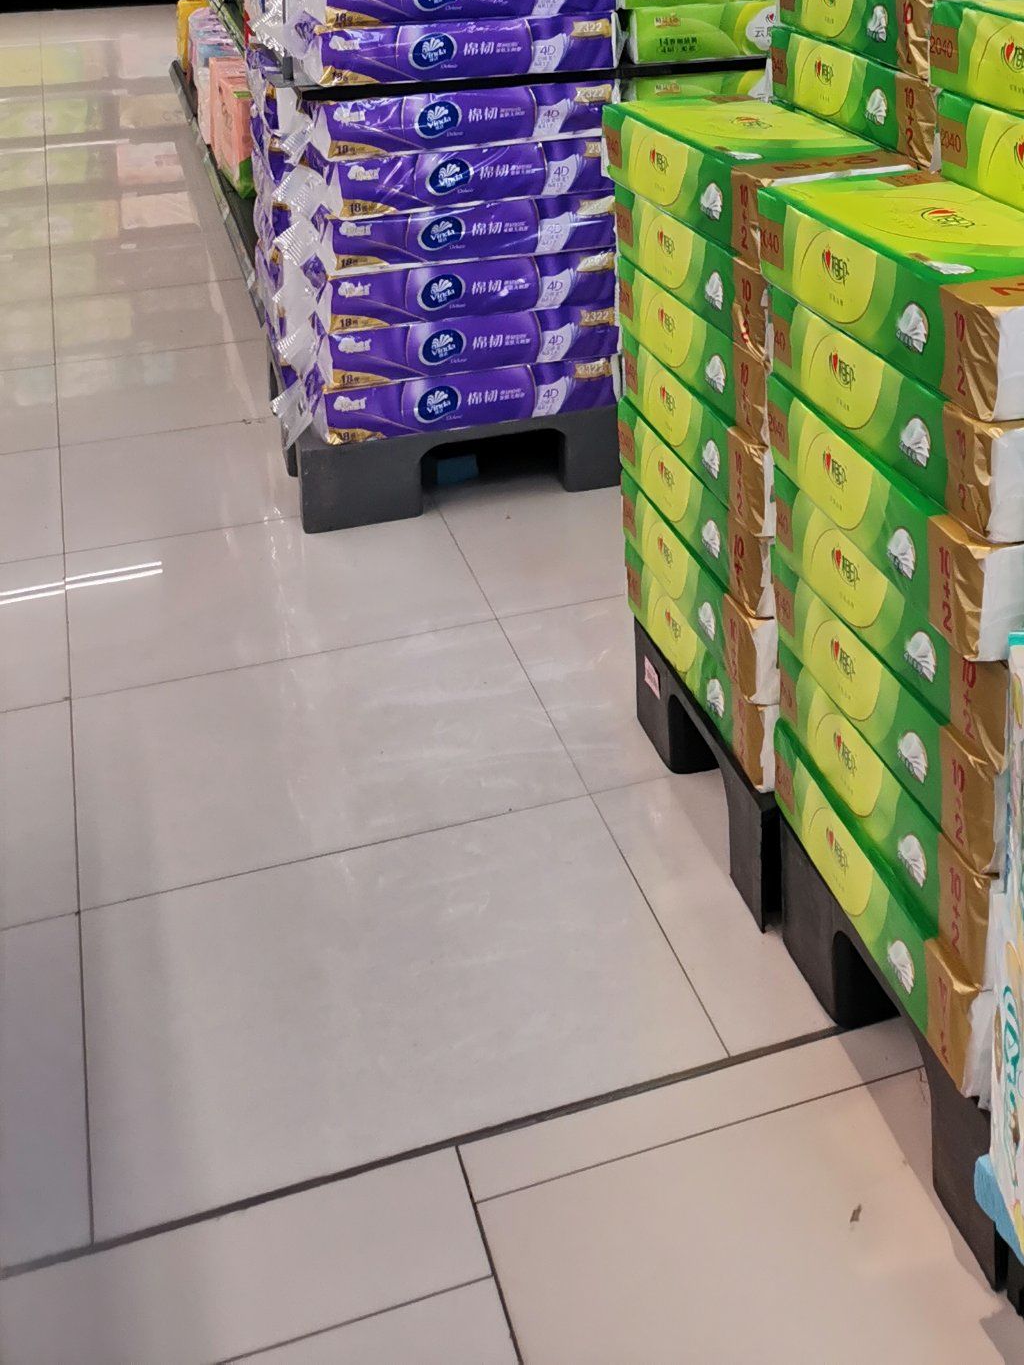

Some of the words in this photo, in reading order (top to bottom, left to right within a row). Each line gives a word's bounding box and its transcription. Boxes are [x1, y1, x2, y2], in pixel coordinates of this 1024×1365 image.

[930, 37, 955, 59] 2040
[421, 49, 446, 61] Vinda
[904, 86, 915, 111] 10
[427, 116, 451, 128] Vinda
[905, 128, 914, 150] 2
[941, 126, 962, 154] 2040
[438, 173, 463, 185] Vinda
[430, 288, 455, 300] Vinda
[431, 344, 456, 356] Vinda
[427, 400, 451, 412] Vinda
[938, 544, 951, 576] 10
